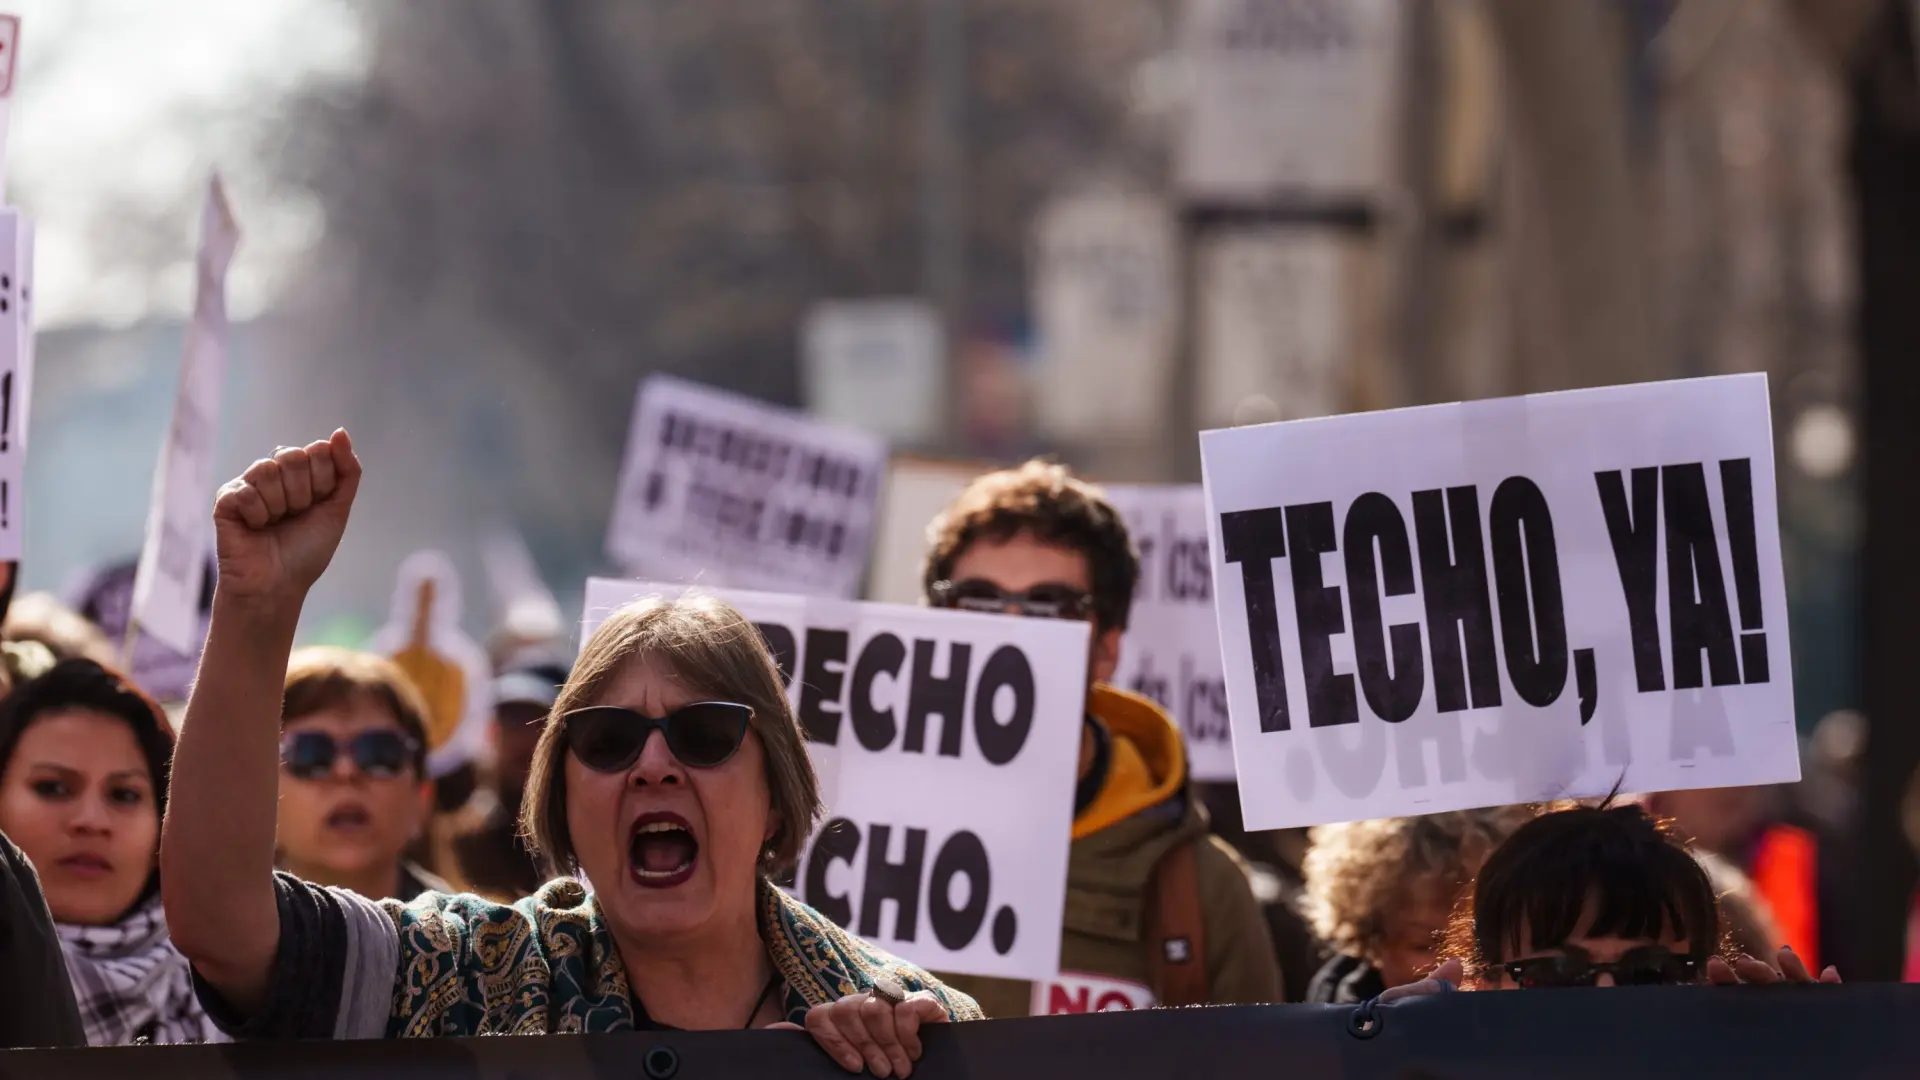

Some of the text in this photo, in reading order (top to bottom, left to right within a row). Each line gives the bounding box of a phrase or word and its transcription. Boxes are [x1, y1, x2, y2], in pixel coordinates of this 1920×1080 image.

[1219, 457, 1770, 734] TECHO, YA!
[773, 817, 1018, 956] CHO.
